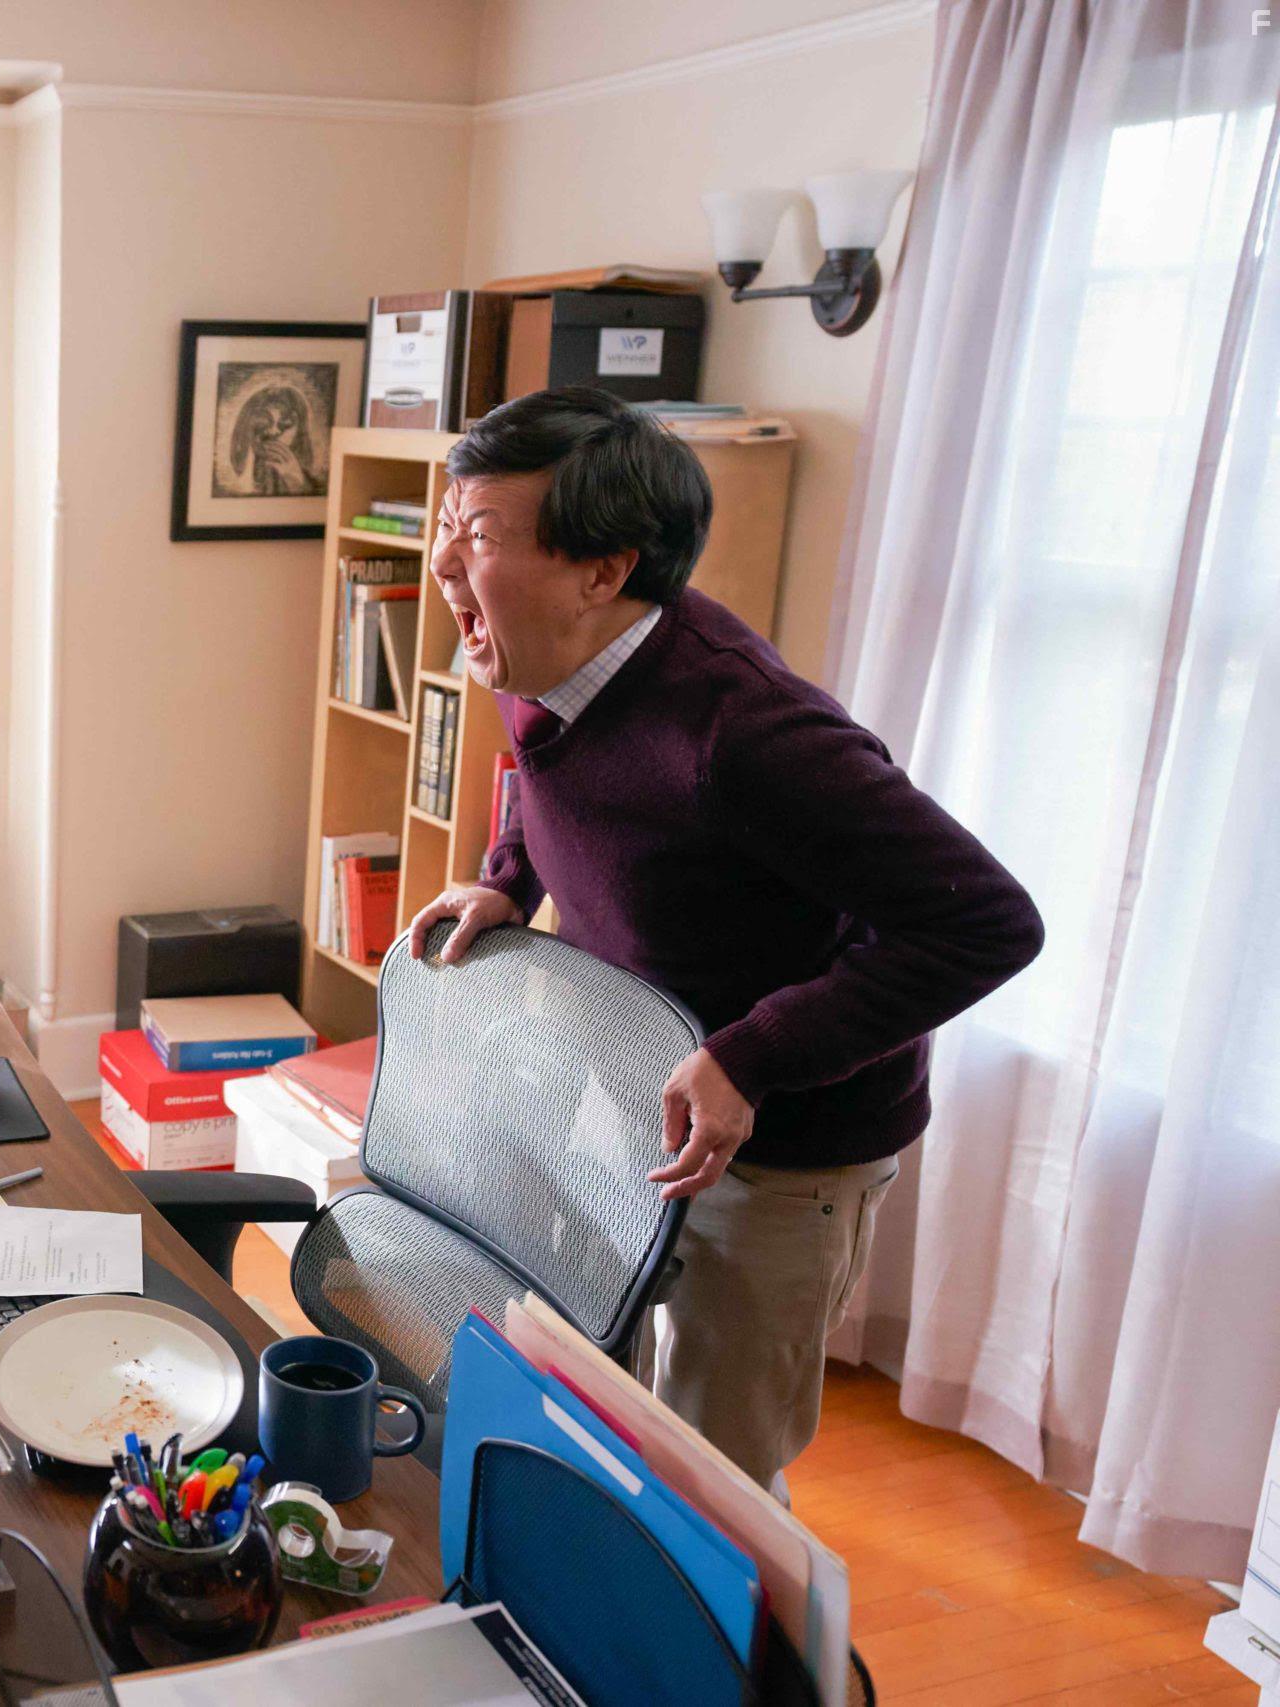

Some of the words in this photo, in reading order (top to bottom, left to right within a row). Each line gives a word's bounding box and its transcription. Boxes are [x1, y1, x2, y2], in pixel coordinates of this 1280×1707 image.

[349, 560, 394, 582] PRADO
[164, 1096, 191, 1106] Office
[164, 1119, 200, 1135] copy
[214, 1115, 236, 1131] prin
